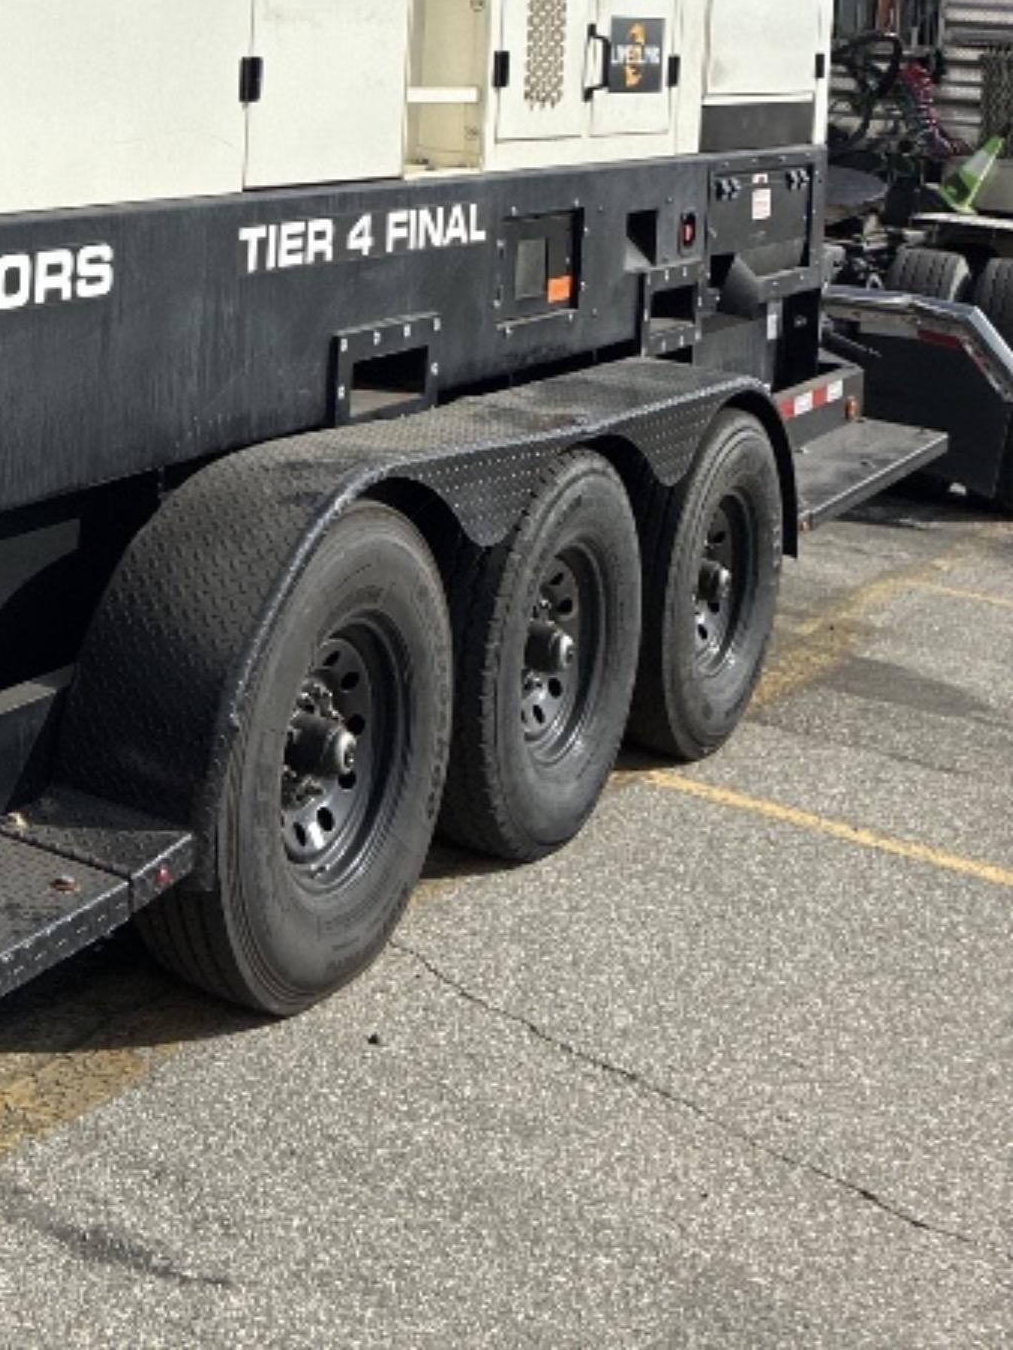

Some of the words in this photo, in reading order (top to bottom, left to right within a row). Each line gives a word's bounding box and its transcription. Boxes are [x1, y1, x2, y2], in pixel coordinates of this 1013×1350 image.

[239, 218, 334, 275] TIER
[346, 213, 375, 256] 4
[385, 203, 487, 254] FINAL
